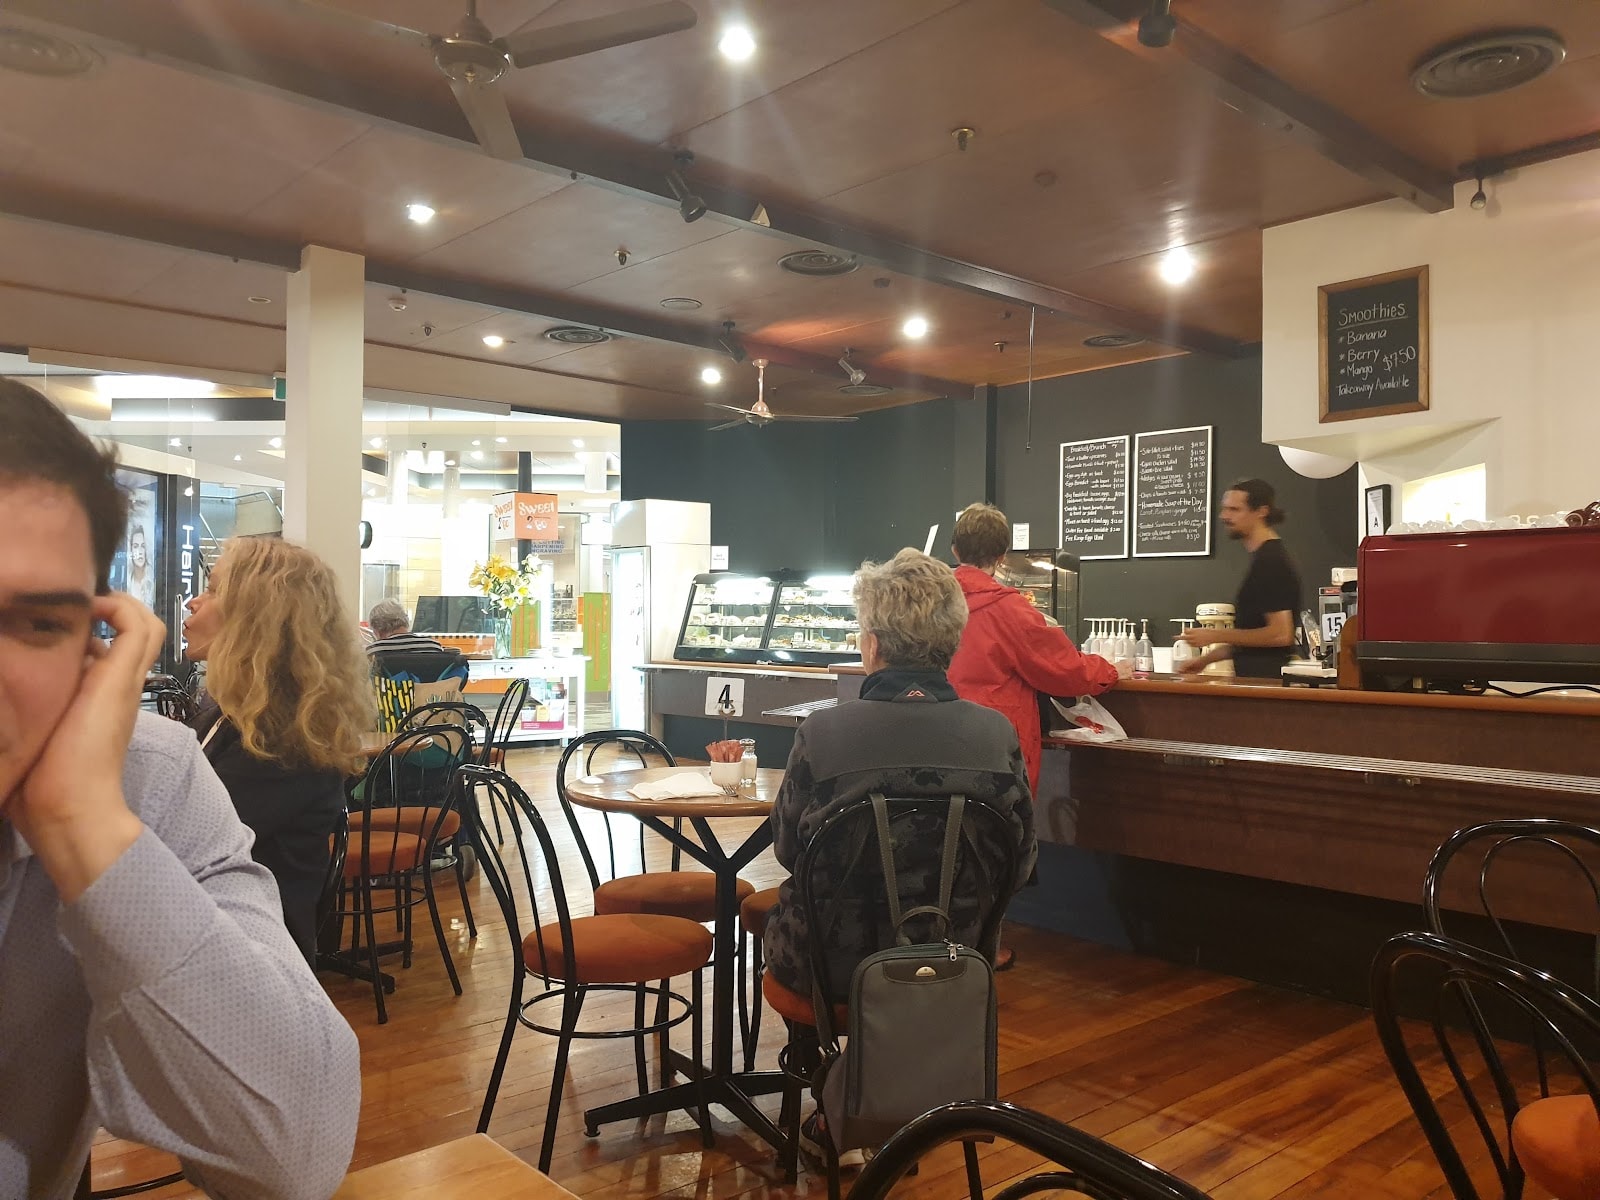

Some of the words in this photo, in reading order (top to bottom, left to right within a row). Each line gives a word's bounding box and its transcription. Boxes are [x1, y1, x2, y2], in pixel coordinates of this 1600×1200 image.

[1339, 302, 1406, 326] Smoothies
[1347, 329, 1387, 345] Banana
[1347, 349, 1380, 363] Berry
[1347, 363, 1373, 380] Mango
[1336, 383, 1374, 399] Takeaway
[1375, 374, 1410, 391] Available
[1191, 496, 1203, 511] Day
[1373, 517, 1379, 528] A
[1326, 616, 1343, 635] 15
[718, 684, 734, 709] 4
